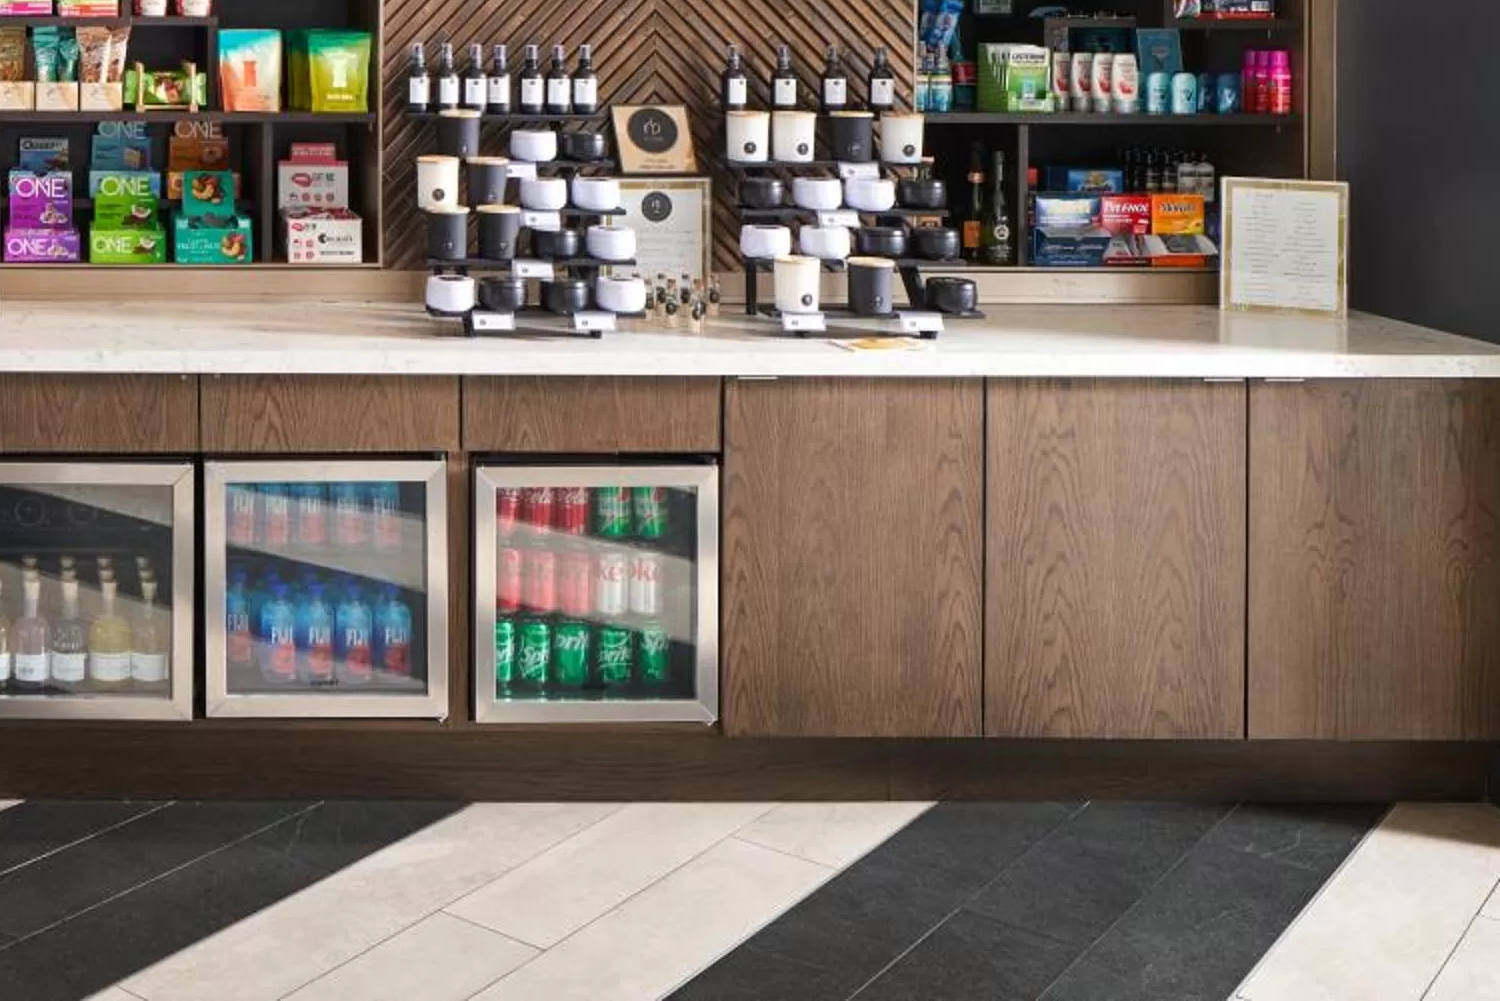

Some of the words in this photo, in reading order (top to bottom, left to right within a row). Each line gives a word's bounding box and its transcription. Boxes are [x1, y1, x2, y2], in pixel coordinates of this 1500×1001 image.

[98, 121, 146, 139] ONE
[174, 120, 222, 138] ONE
[16, 178, 66, 198] ONE
[101, 176, 149, 196] ONE
[7, 238, 48, 256] ONE
[94, 237, 132, 254] ONE
